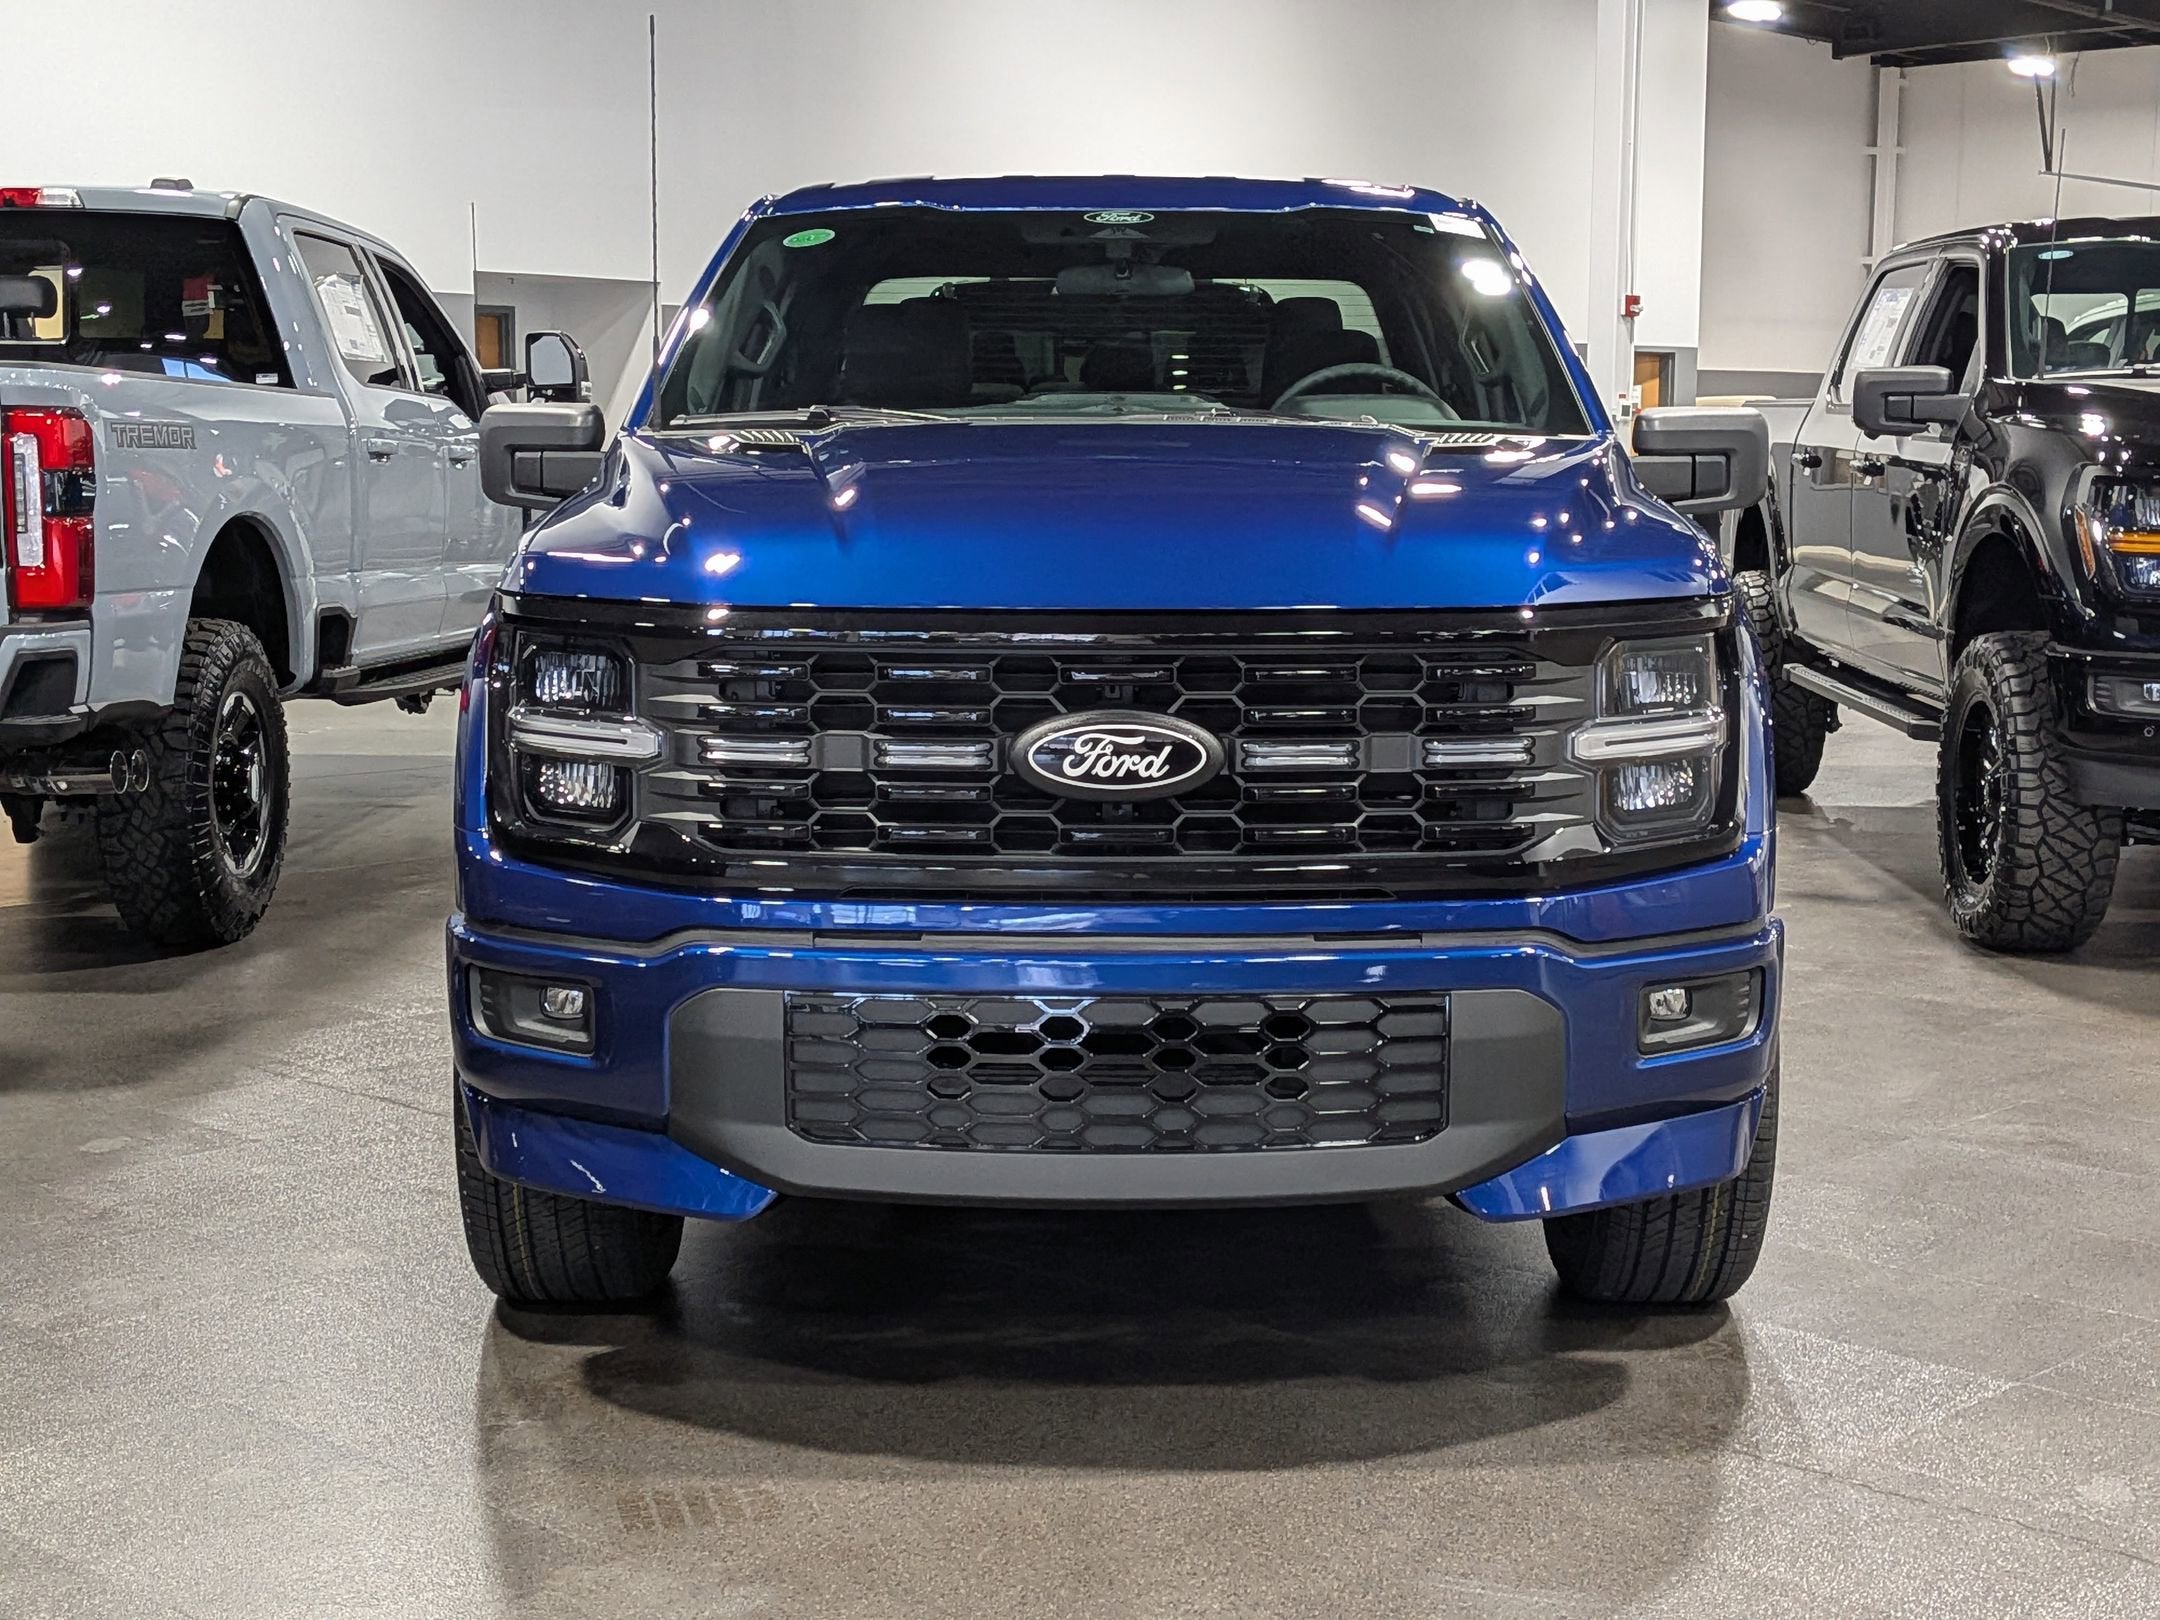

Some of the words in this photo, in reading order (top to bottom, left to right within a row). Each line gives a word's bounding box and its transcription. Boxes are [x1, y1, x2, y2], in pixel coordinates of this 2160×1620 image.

[1096, 212, 1142, 221] Ford
[111, 422, 197, 449] TREMOR
[1062, 733, 1173, 778] Ford
